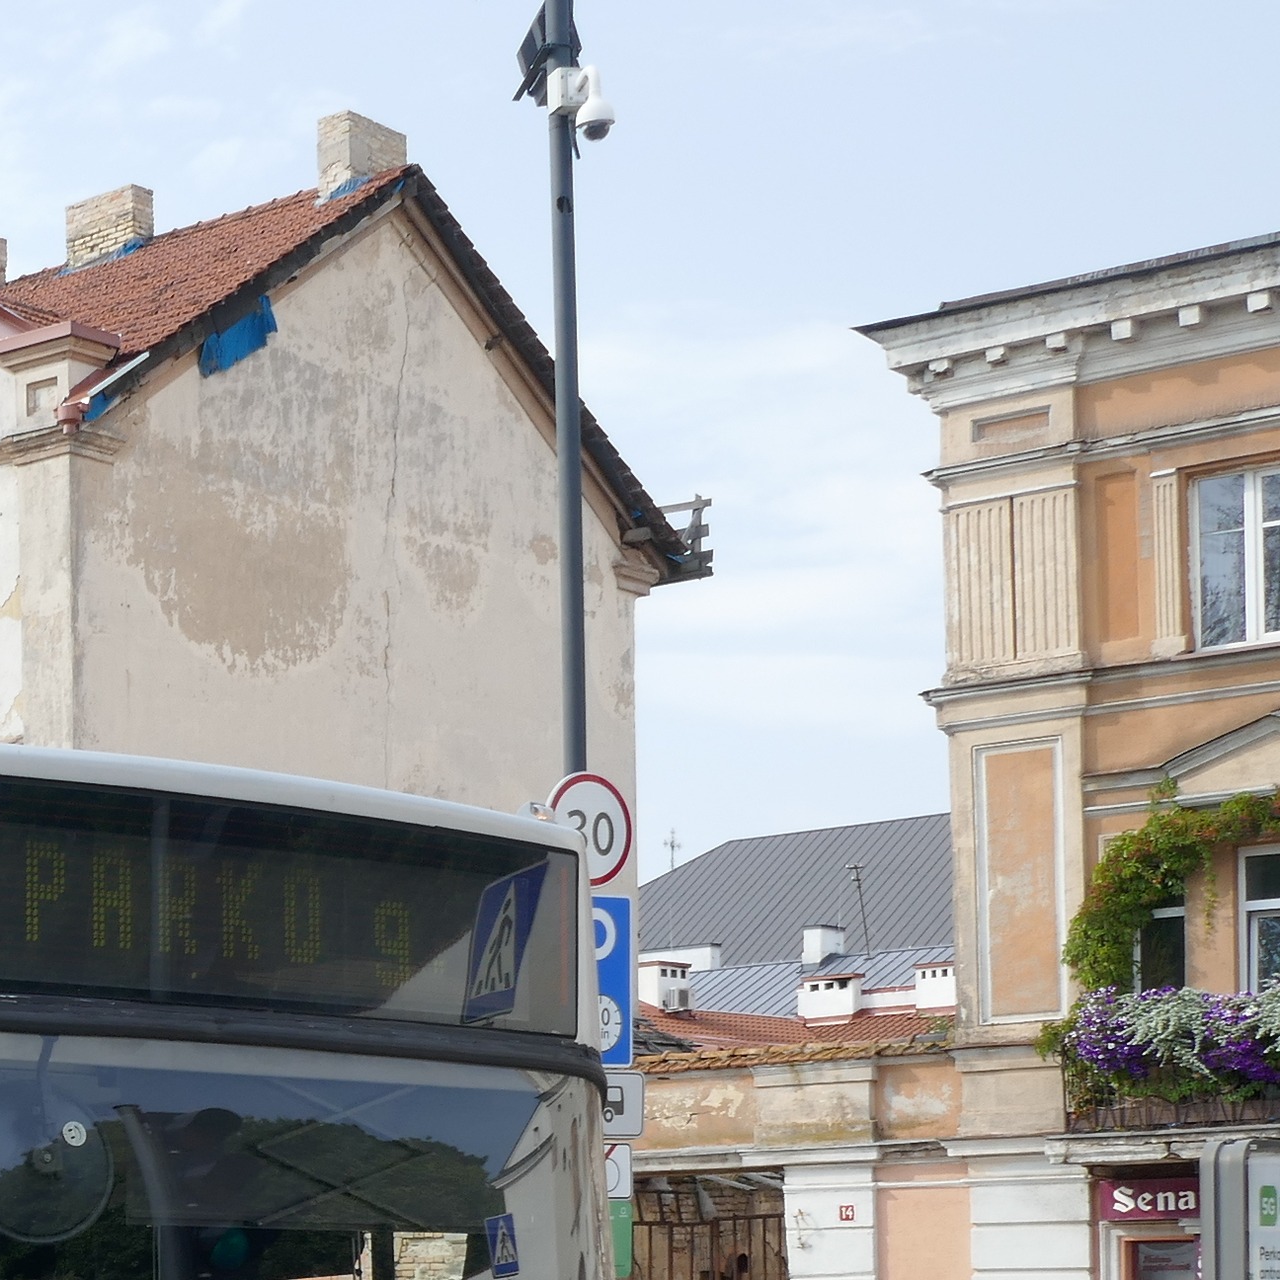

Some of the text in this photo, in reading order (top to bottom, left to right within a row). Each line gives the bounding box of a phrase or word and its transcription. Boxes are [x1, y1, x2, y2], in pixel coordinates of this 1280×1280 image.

[566, 809, 614, 856] 30
[25, 840, 321, 964] PARKO
[841, 1206, 853, 1219] 14
[1112, 1185, 1197, 1213] Sena
[1261, 1197, 1276, 1215] 5G
